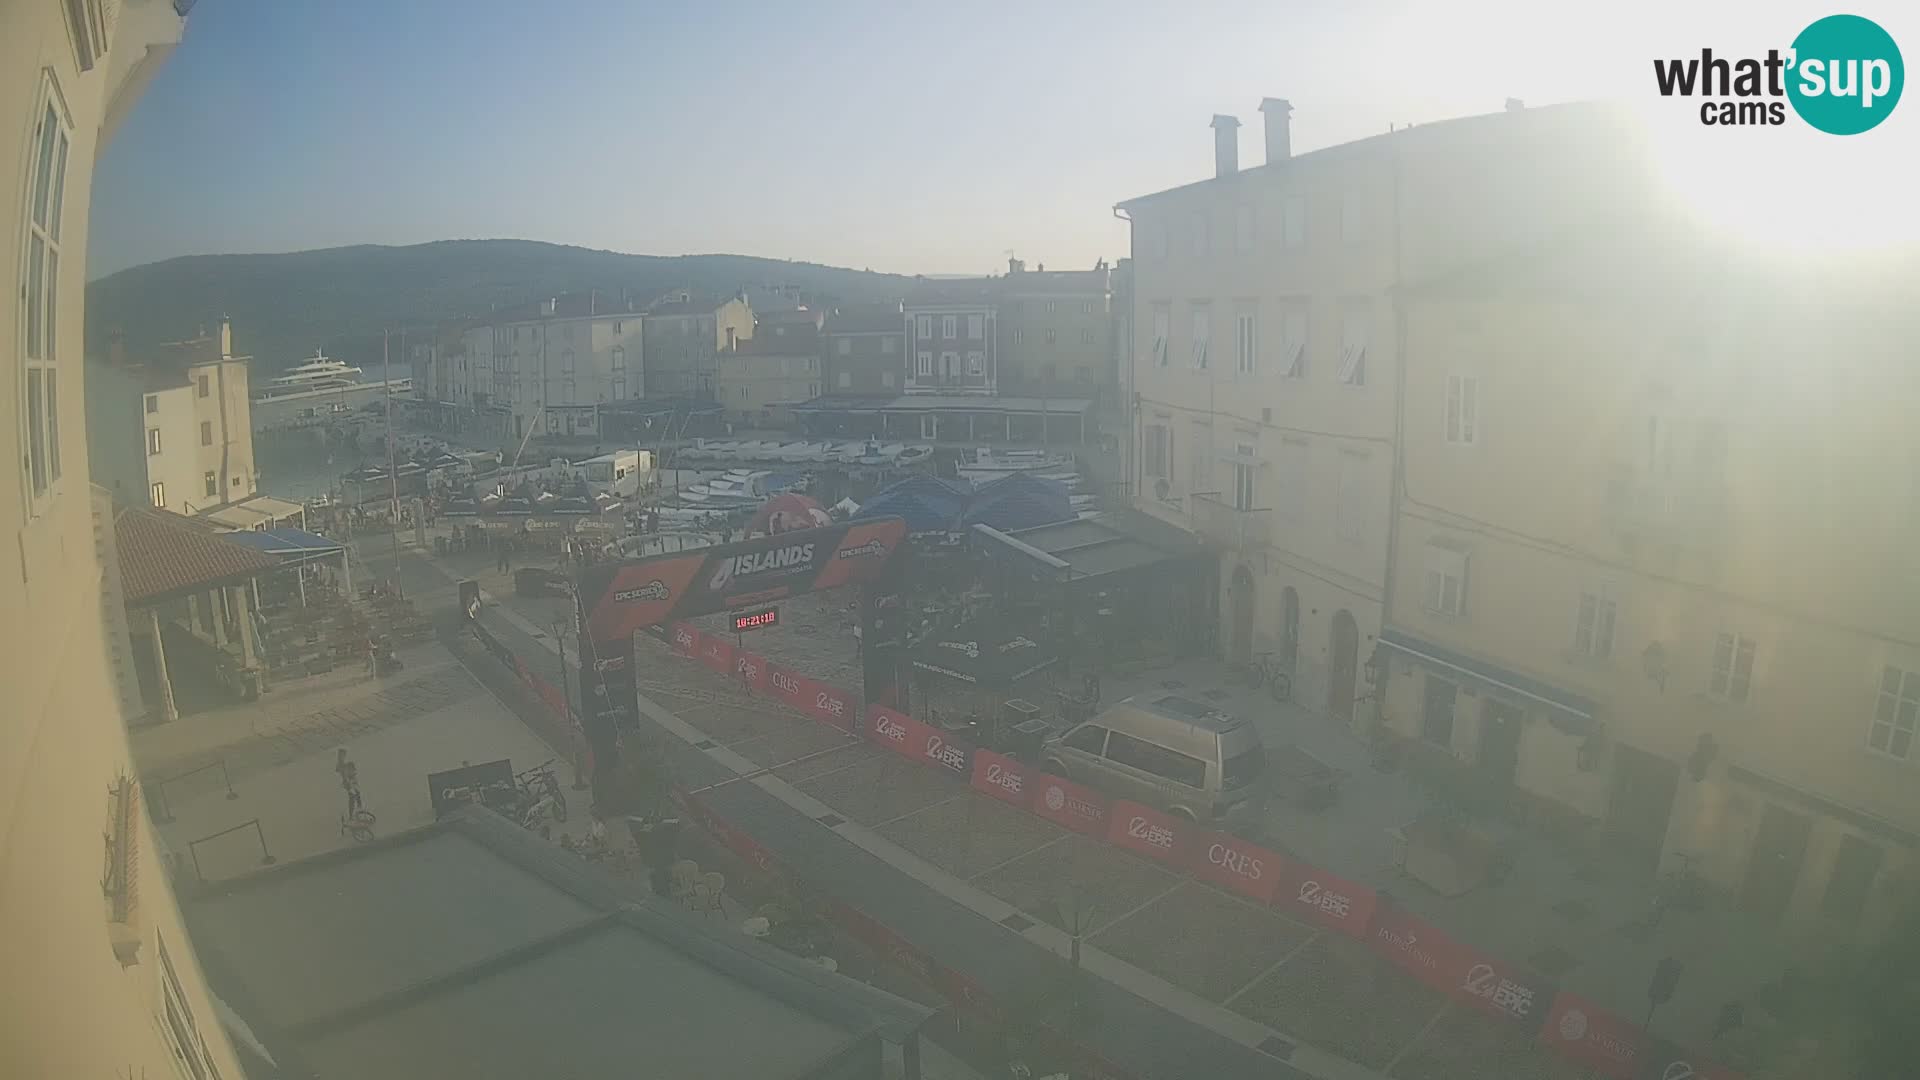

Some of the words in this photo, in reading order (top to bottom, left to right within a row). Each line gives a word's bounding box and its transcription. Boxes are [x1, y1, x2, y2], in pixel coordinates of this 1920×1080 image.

[734, 543, 815, 576] ISLANDS
[942, 750, 966, 770] EPIC
[1001, 776, 1023, 793] EPIC
[1147, 830, 1174, 848] EPIC
[1208, 843, 1264, 880] CRES
[1320, 895, 1350, 917] EPIC
[1493, 986, 1532, 1015] EPIC
